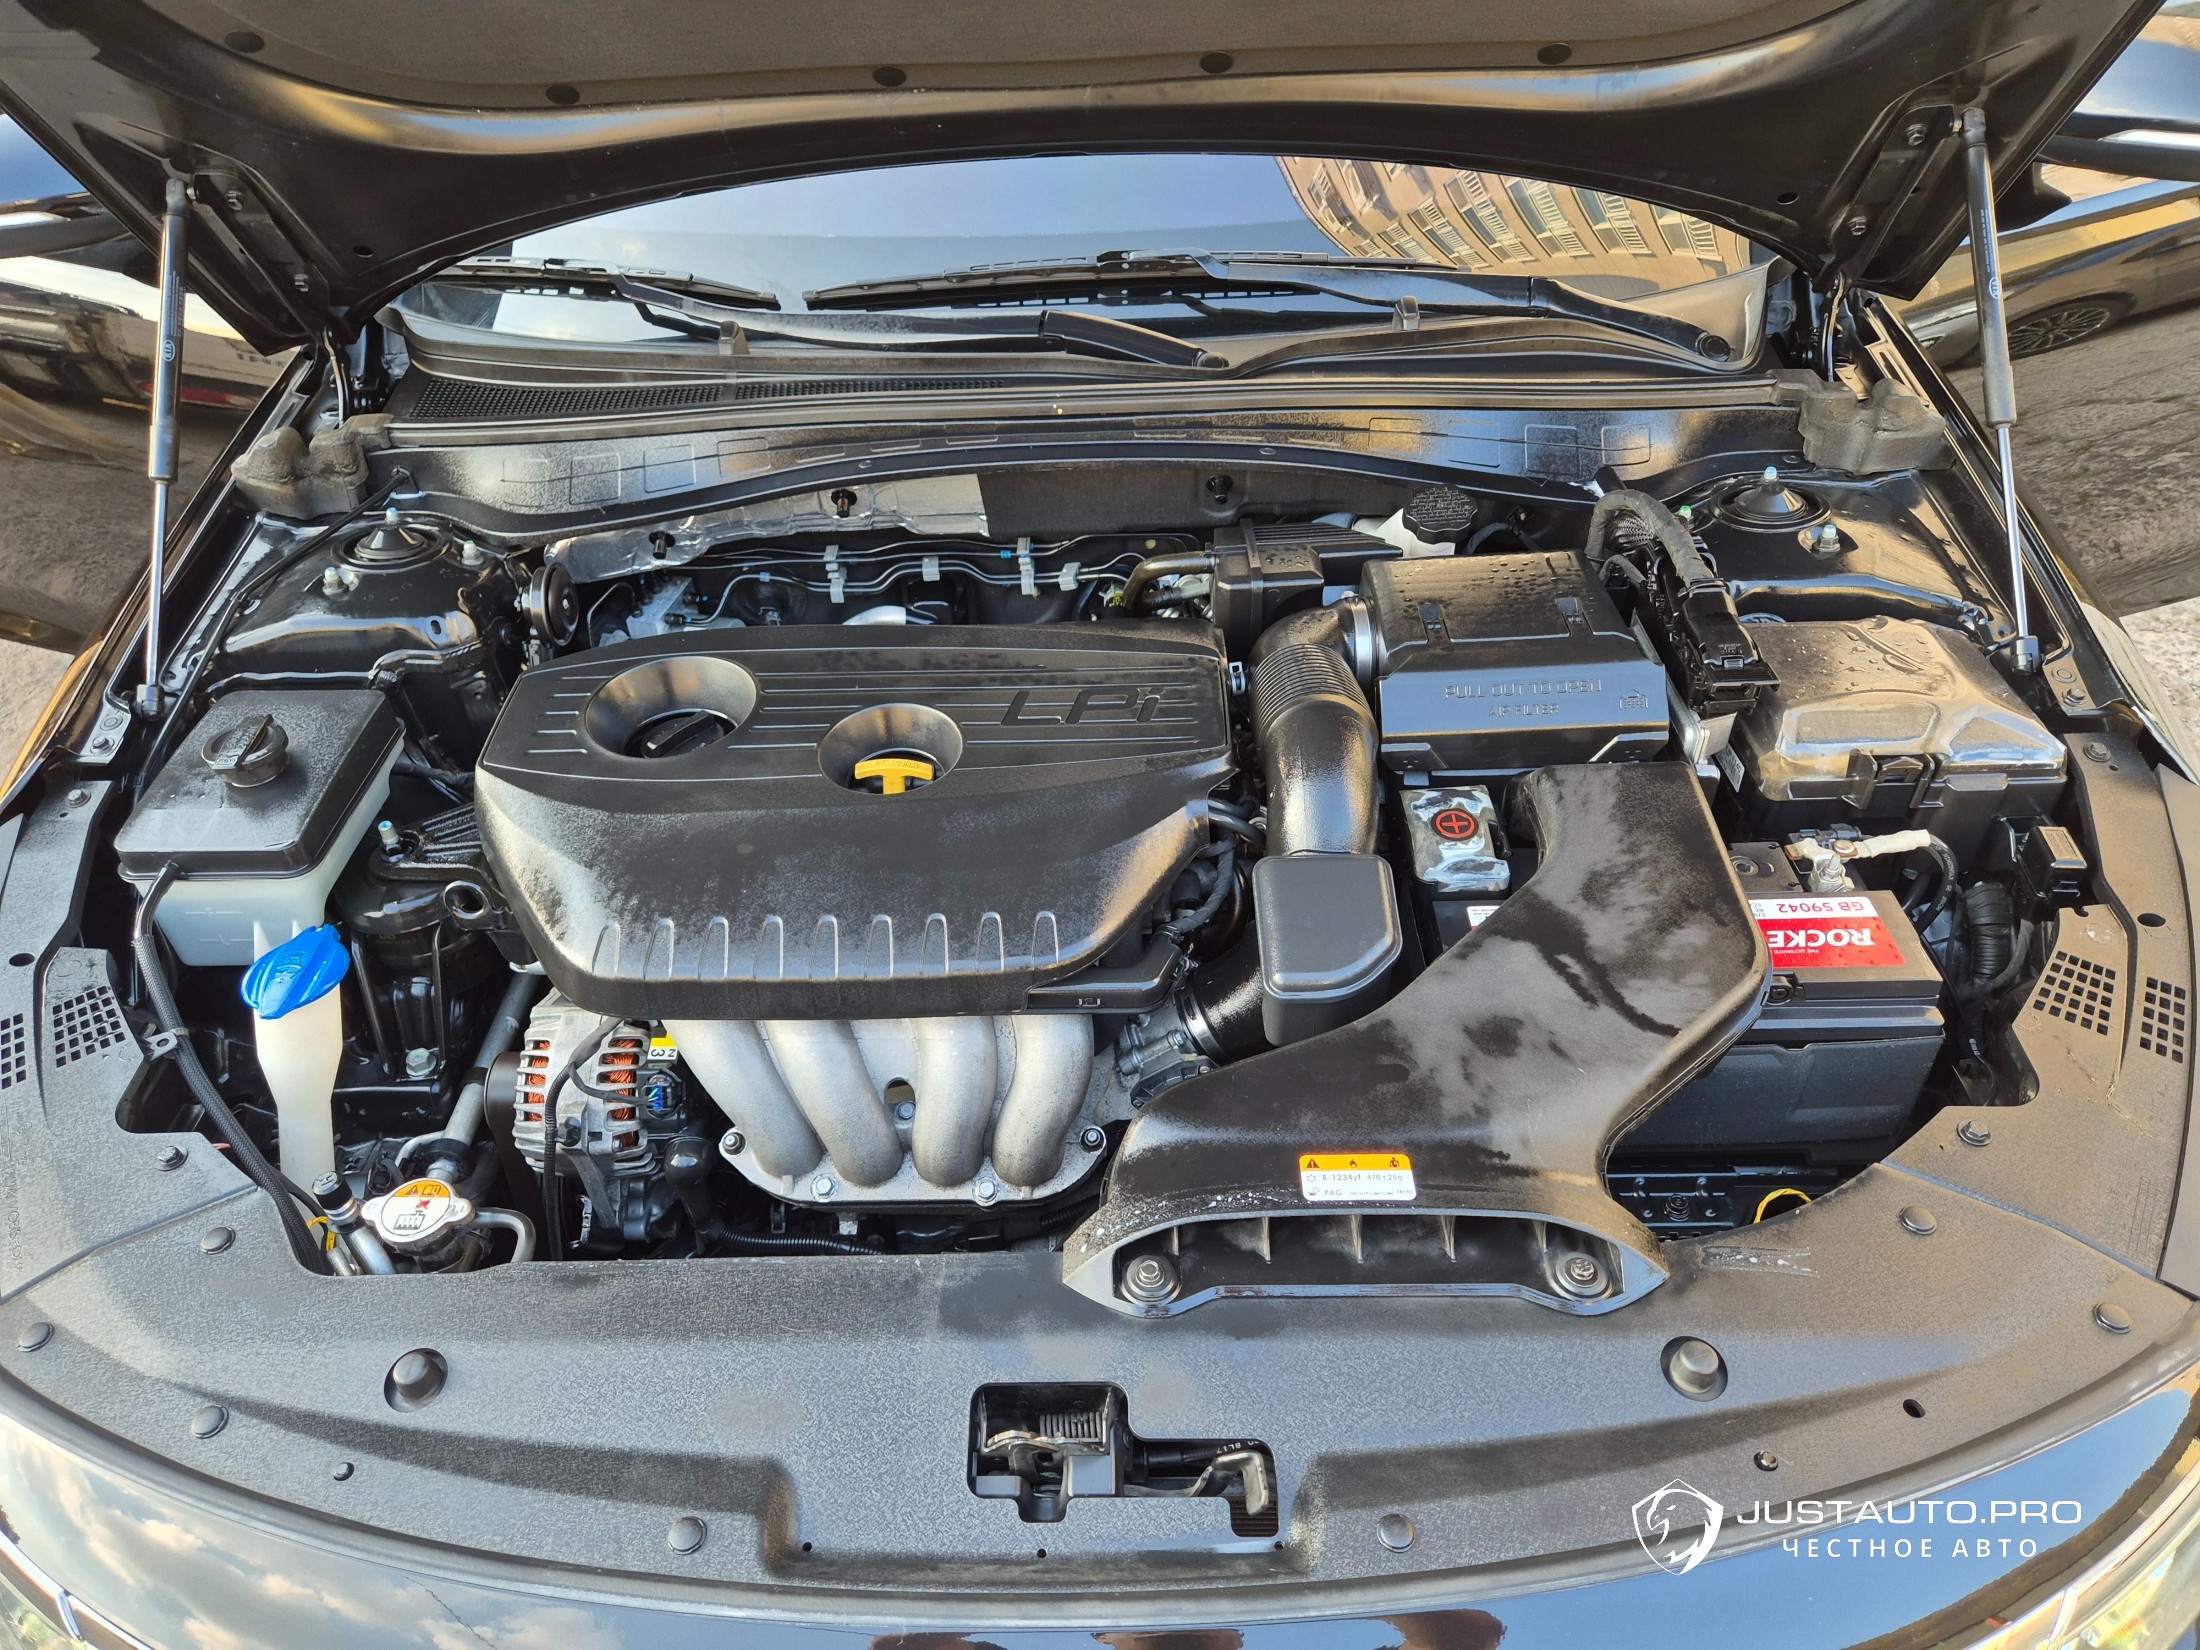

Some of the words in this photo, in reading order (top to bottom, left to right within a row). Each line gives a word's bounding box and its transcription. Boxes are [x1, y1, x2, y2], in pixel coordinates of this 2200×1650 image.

[1444, 684, 1485, 700] PULL
[1491, 681, 1523, 697] OUT
[1529, 680, 1551, 695] TO
[1556, 678, 1602, 694] OPEN
[1000, 687, 1165, 726] LPi
[1488, 704, 1510, 718] AIR
[1515, 703, 1560, 717] FILTER
[1776, 902, 1833, 913] 59042
[1838, 901, 1864, 912] GB
[1766, 928, 1876, 948] ROCKE
[1322, 1174, 1361, 1182] R-1234yf
[1366, 1174, 1403, 1182] 470±25g
